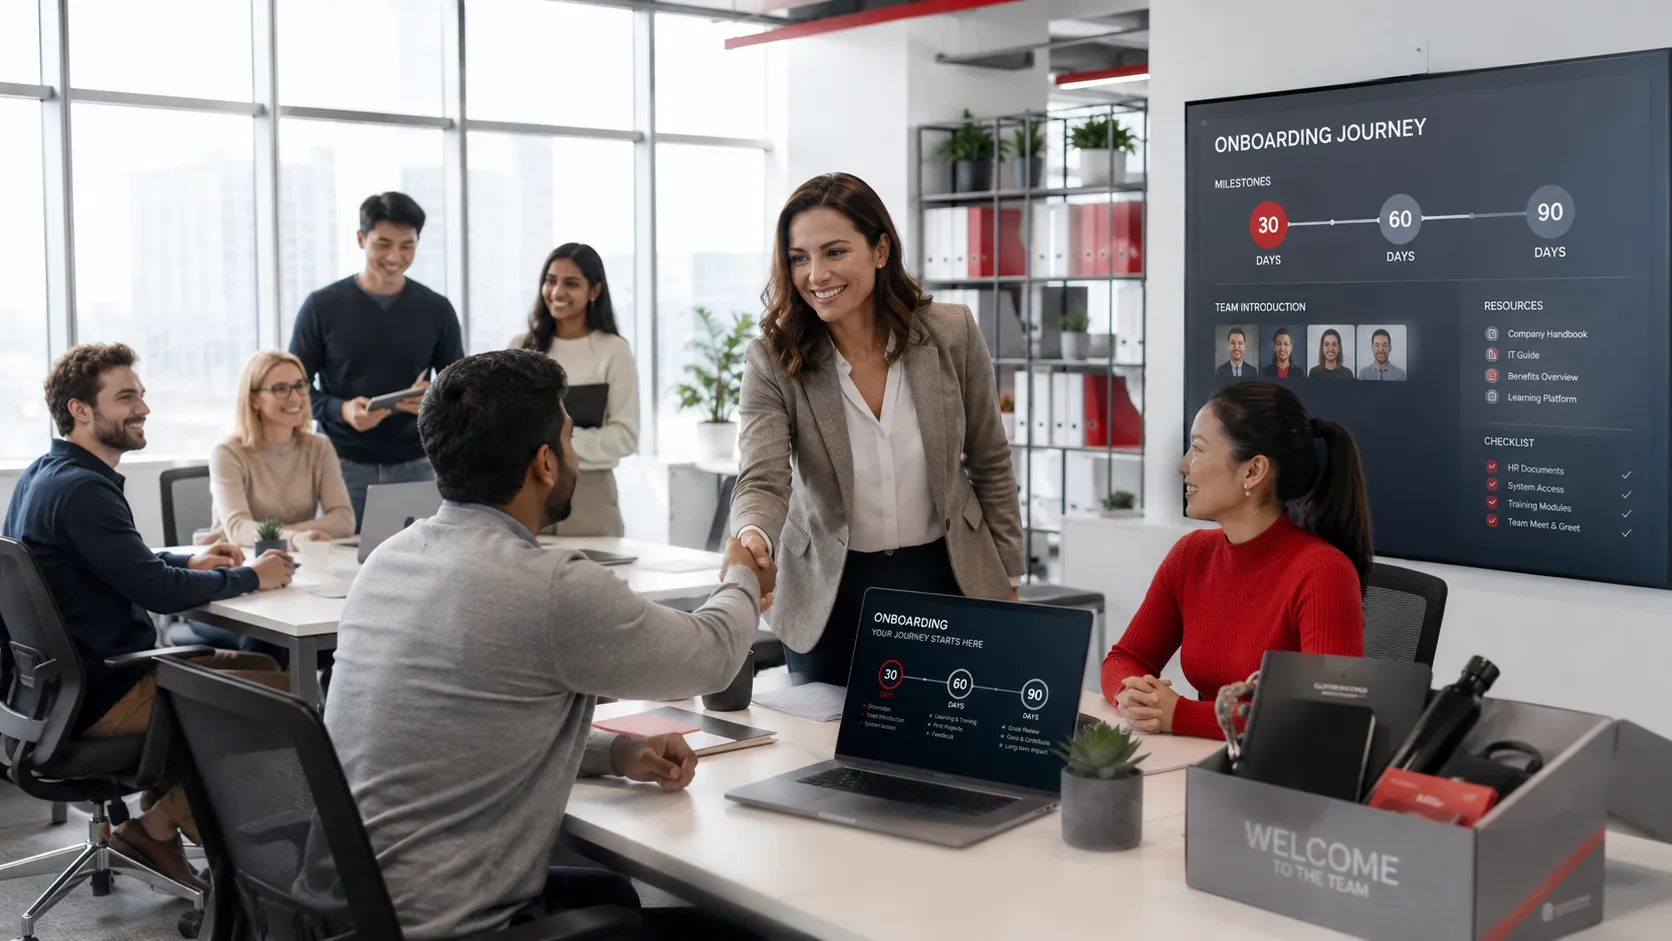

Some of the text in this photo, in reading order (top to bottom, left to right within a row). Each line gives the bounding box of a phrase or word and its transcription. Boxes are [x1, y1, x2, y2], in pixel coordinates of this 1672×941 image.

[1215, 117, 1427, 153] ONBOARDING JOURNEY
[1215, 176, 1271, 189] MILESTONES
[1537, 202, 1564, 221] 90
[1258, 216, 1279, 234] 30
[1388, 210, 1412, 228] 60
[1386, 251, 1415, 262] DAYS
[1534, 246, 1566, 258] DAYS
[1256, 255, 1281, 265] DAYS
[1215, 302, 1306, 312] TEAM INTRODUCTION
[1484, 301, 1543, 311] RESOURCES
[1508, 330, 1588, 340] Company Handbook
[1508, 351, 1540, 360] IT Guide
[1508, 372, 1579, 381] Benefits Overview
[1508, 393, 1577, 404] Learning Platform
[1484, 436, 1535, 447] CHECKLIST
[1508, 464, 1565, 475] HR Documents
[1508, 482, 1565, 494] System Access
[1508, 500, 1572, 513] Training Modules
[1508, 518, 1580, 533] Team Meet & Greet
[874, 612, 948, 630] ONBOARDING
[872, 628, 984, 649] YOUR JOURNEY STARTS HERE
[884, 669, 898, 680] 30
[953, 678, 968, 690] 60
[1027, 688, 1043, 701] 90
[948, 701, 965, 710] DAYS
[1022, 712, 1040, 721] DAYS
[1245, 821, 1399, 886] WELCOME
[1272, 858, 1370, 898] TO THE TEAM
